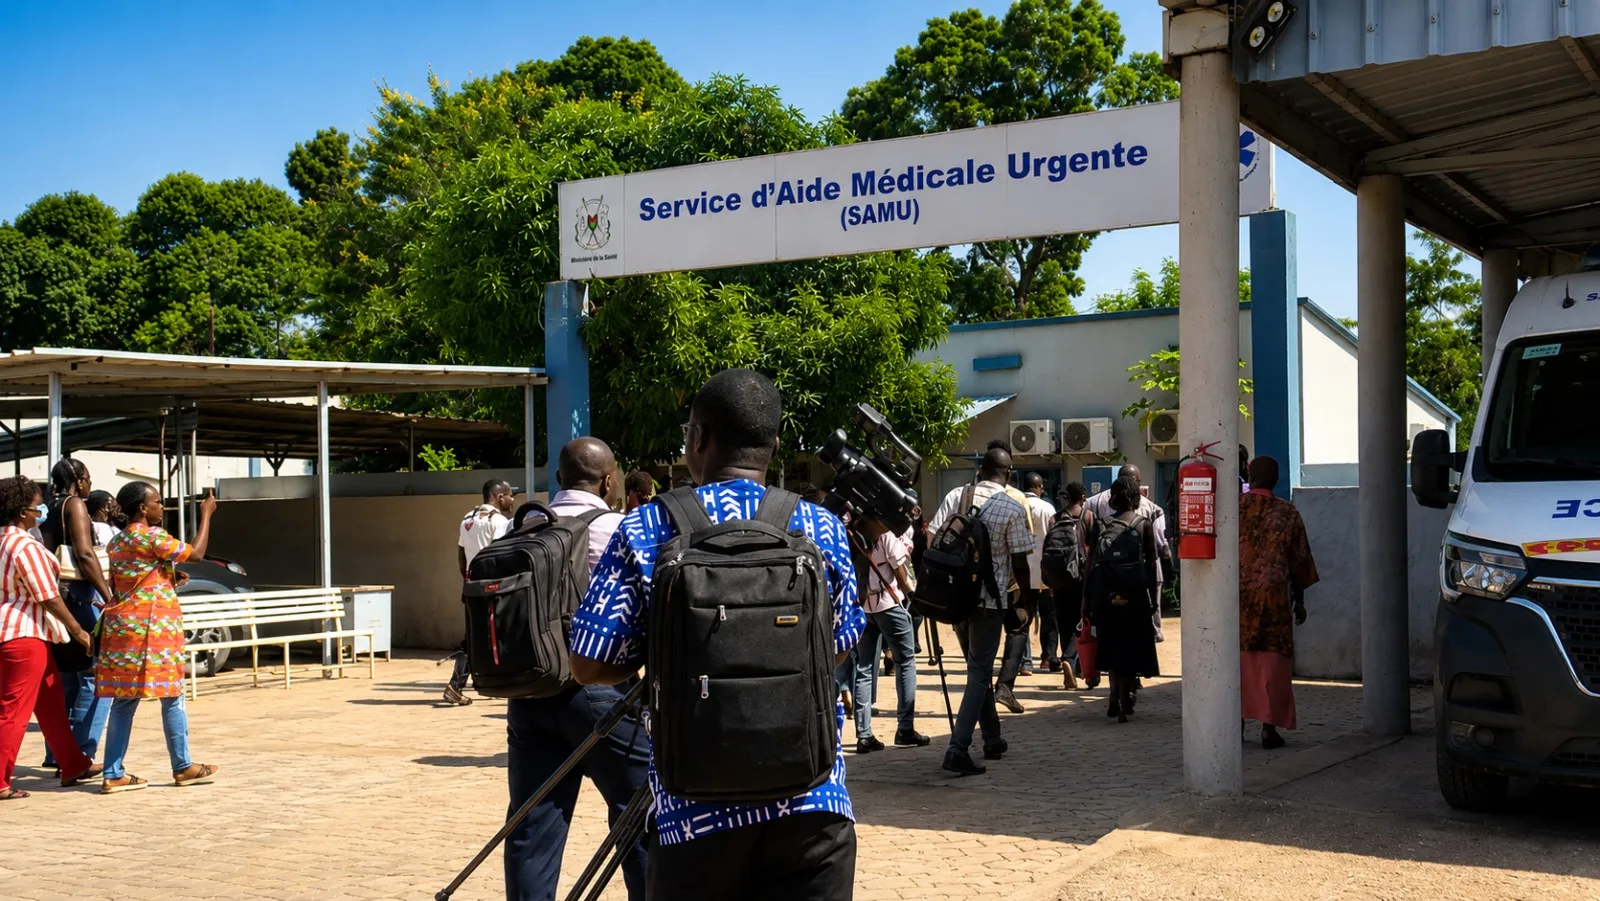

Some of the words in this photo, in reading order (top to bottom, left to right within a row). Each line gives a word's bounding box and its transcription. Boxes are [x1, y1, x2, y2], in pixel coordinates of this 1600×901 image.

[639, 191, 743, 223] Service
[752, 177, 842, 208] d’Aide
[851, 155, 996, 198] Médicale
[1007, 143, 1149, 183] Urgente
[840, 199, 921, 228] (SAMU)
